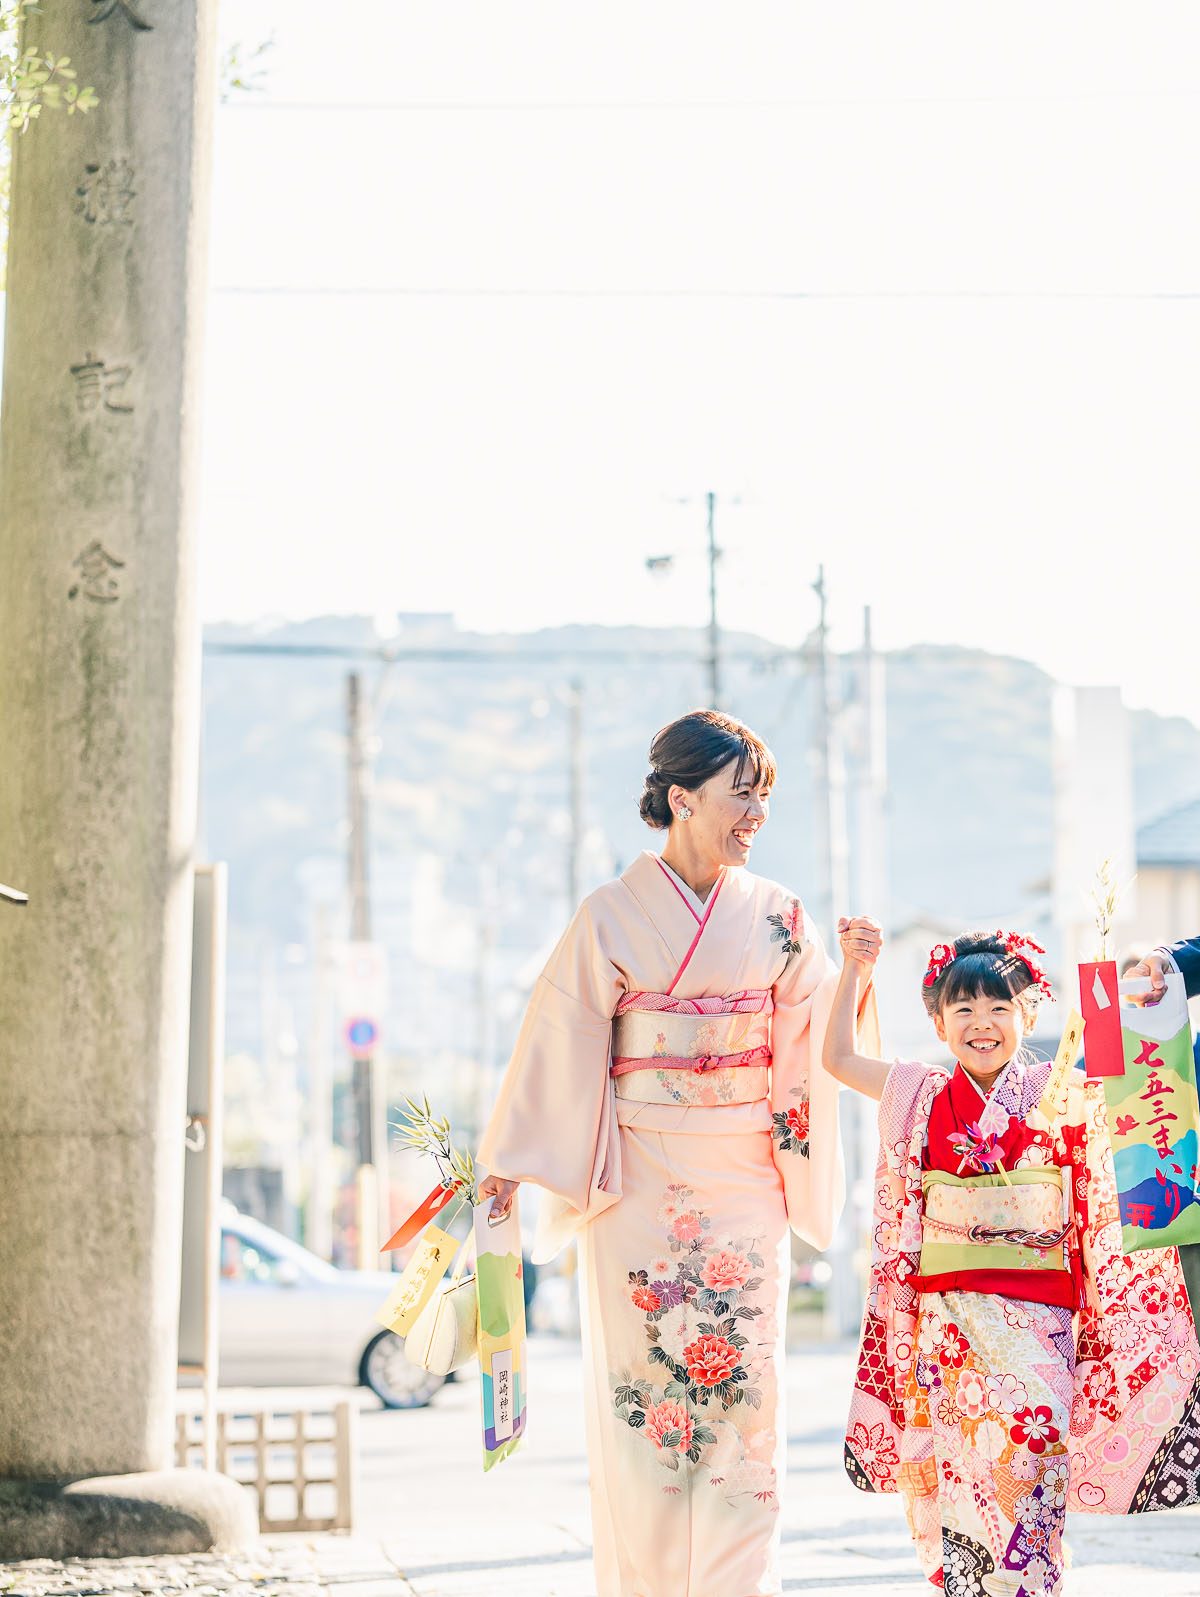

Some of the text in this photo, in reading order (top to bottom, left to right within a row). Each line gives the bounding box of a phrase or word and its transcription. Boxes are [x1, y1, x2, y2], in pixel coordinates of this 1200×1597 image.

[1132, 1039, 1181, 1228] 七五三まいり
